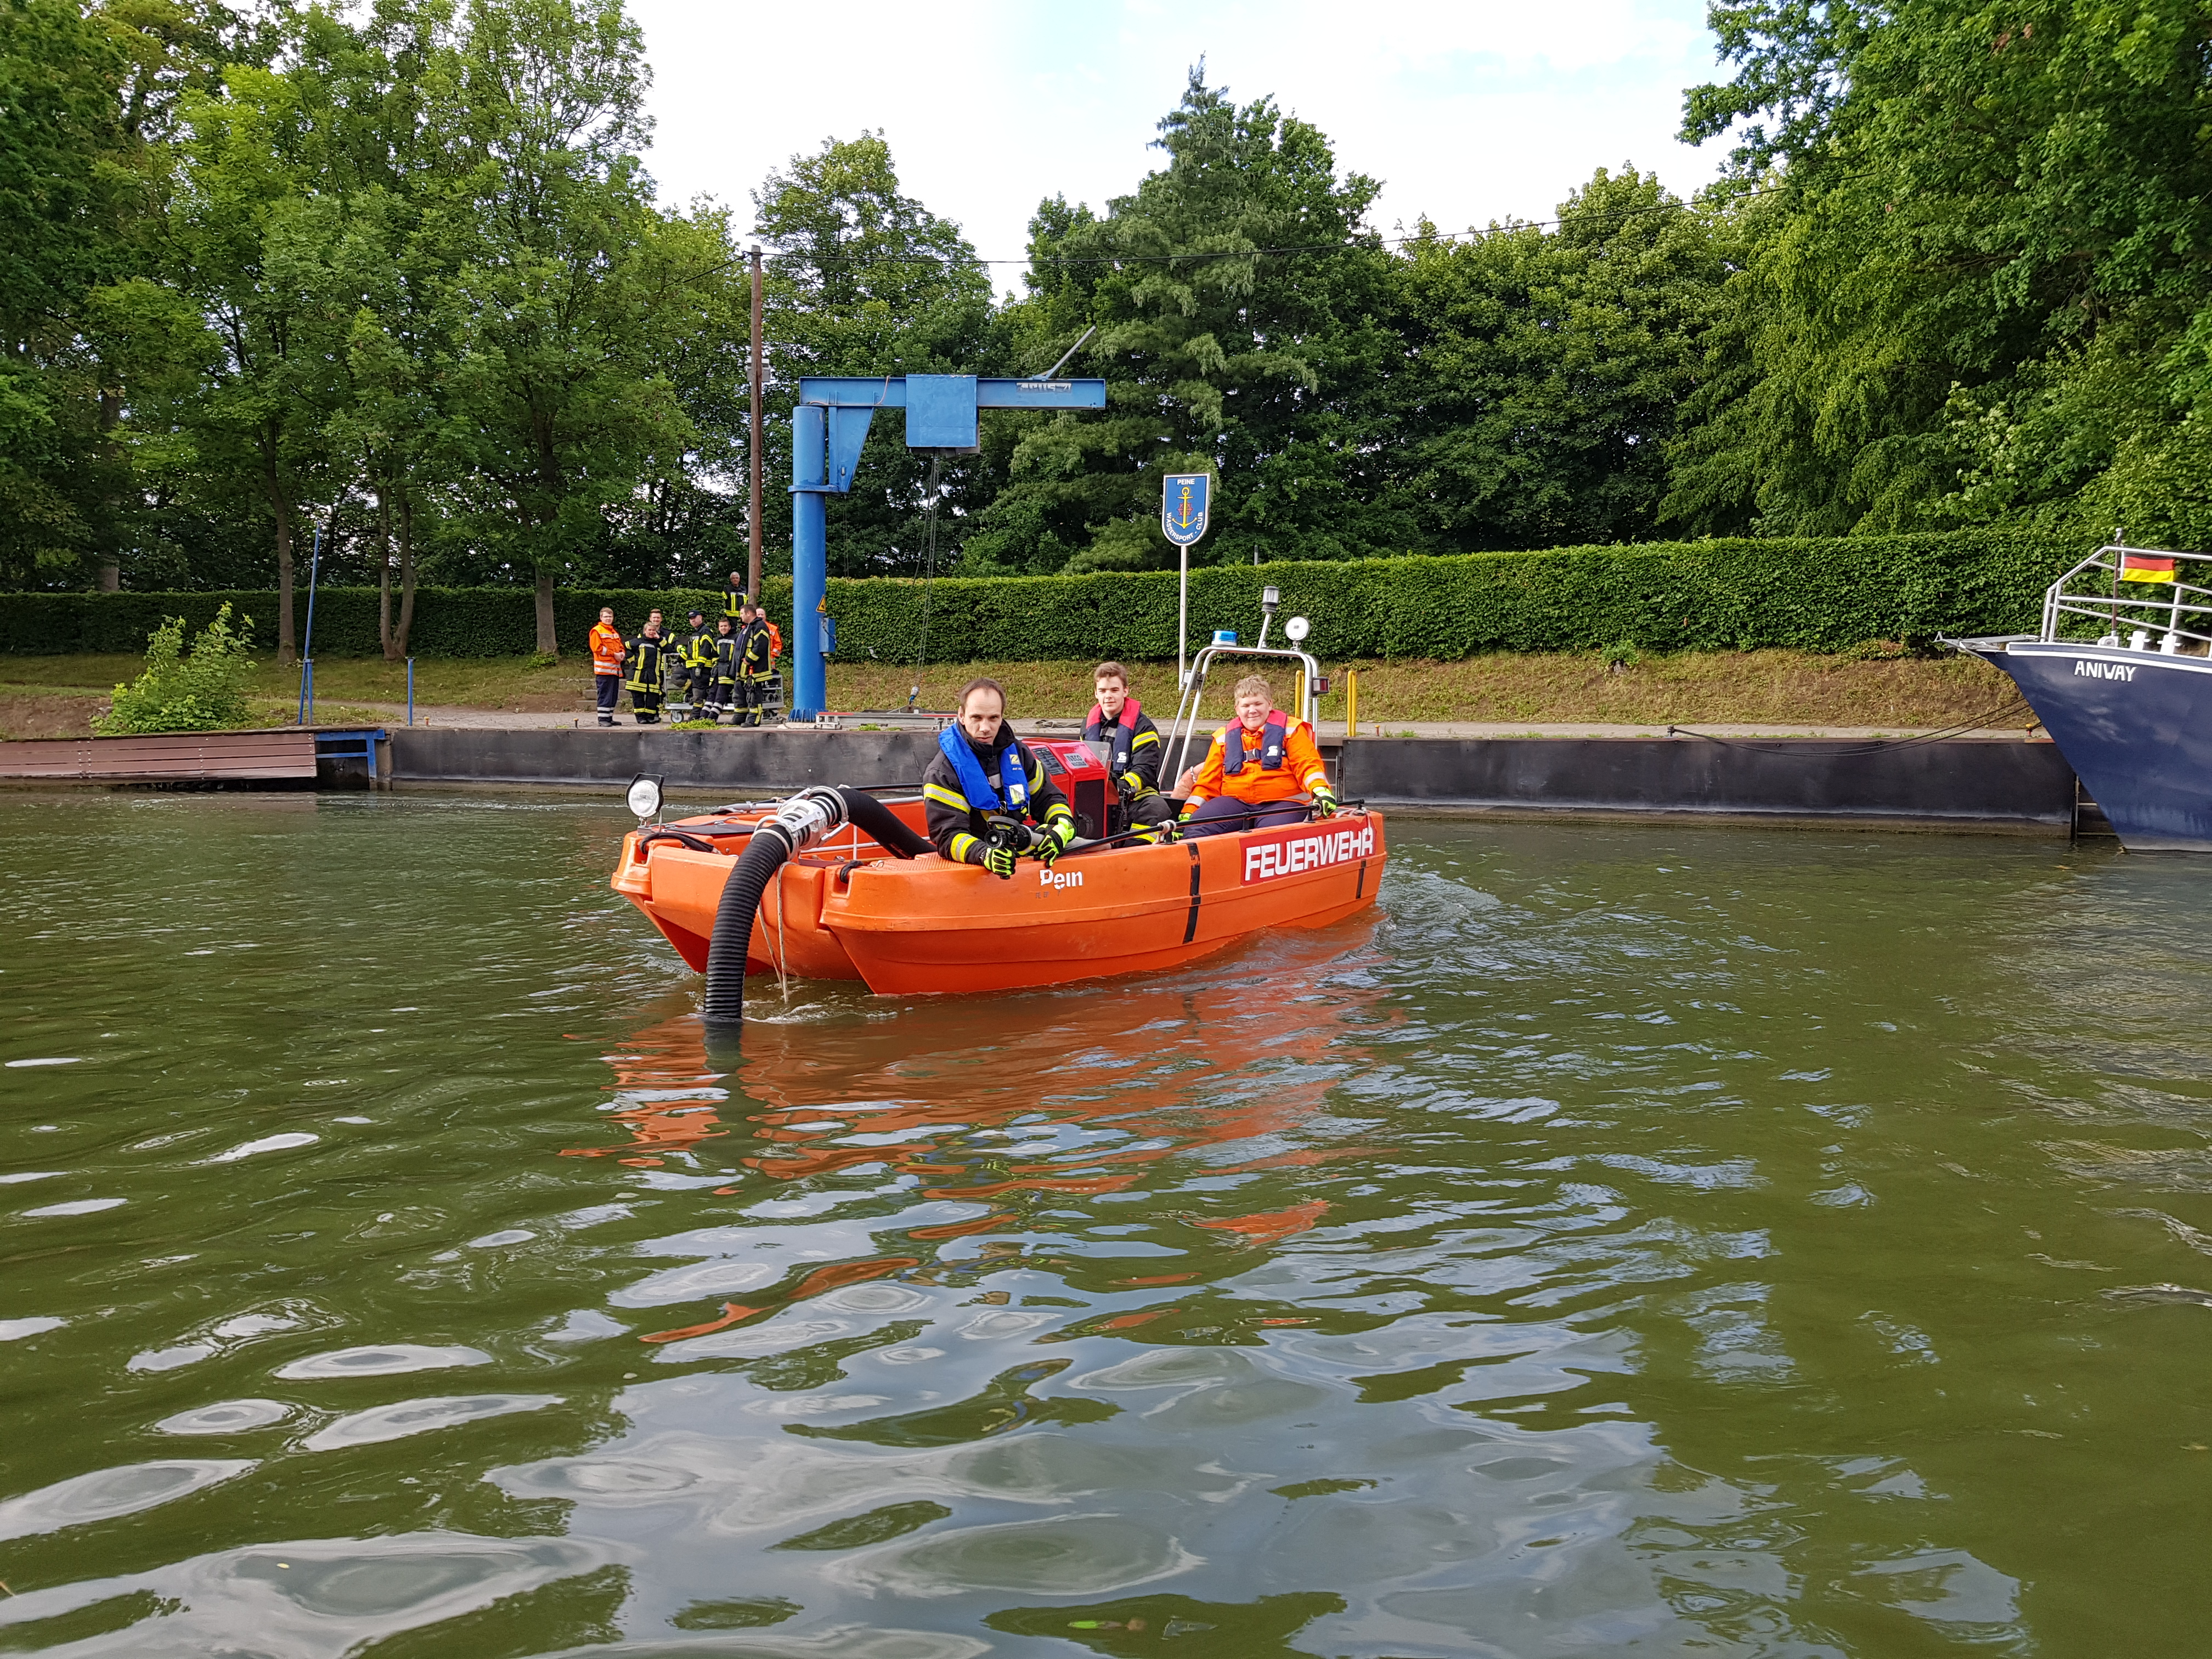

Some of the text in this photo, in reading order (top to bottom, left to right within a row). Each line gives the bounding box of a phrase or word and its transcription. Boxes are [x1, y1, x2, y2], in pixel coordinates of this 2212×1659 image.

[1166, 512, 1194, 541] WASSERSPORT
[2074, 661, 2137, 682] ANIWAY
[1245, 827, 1373, 881] FEUERWEHR
